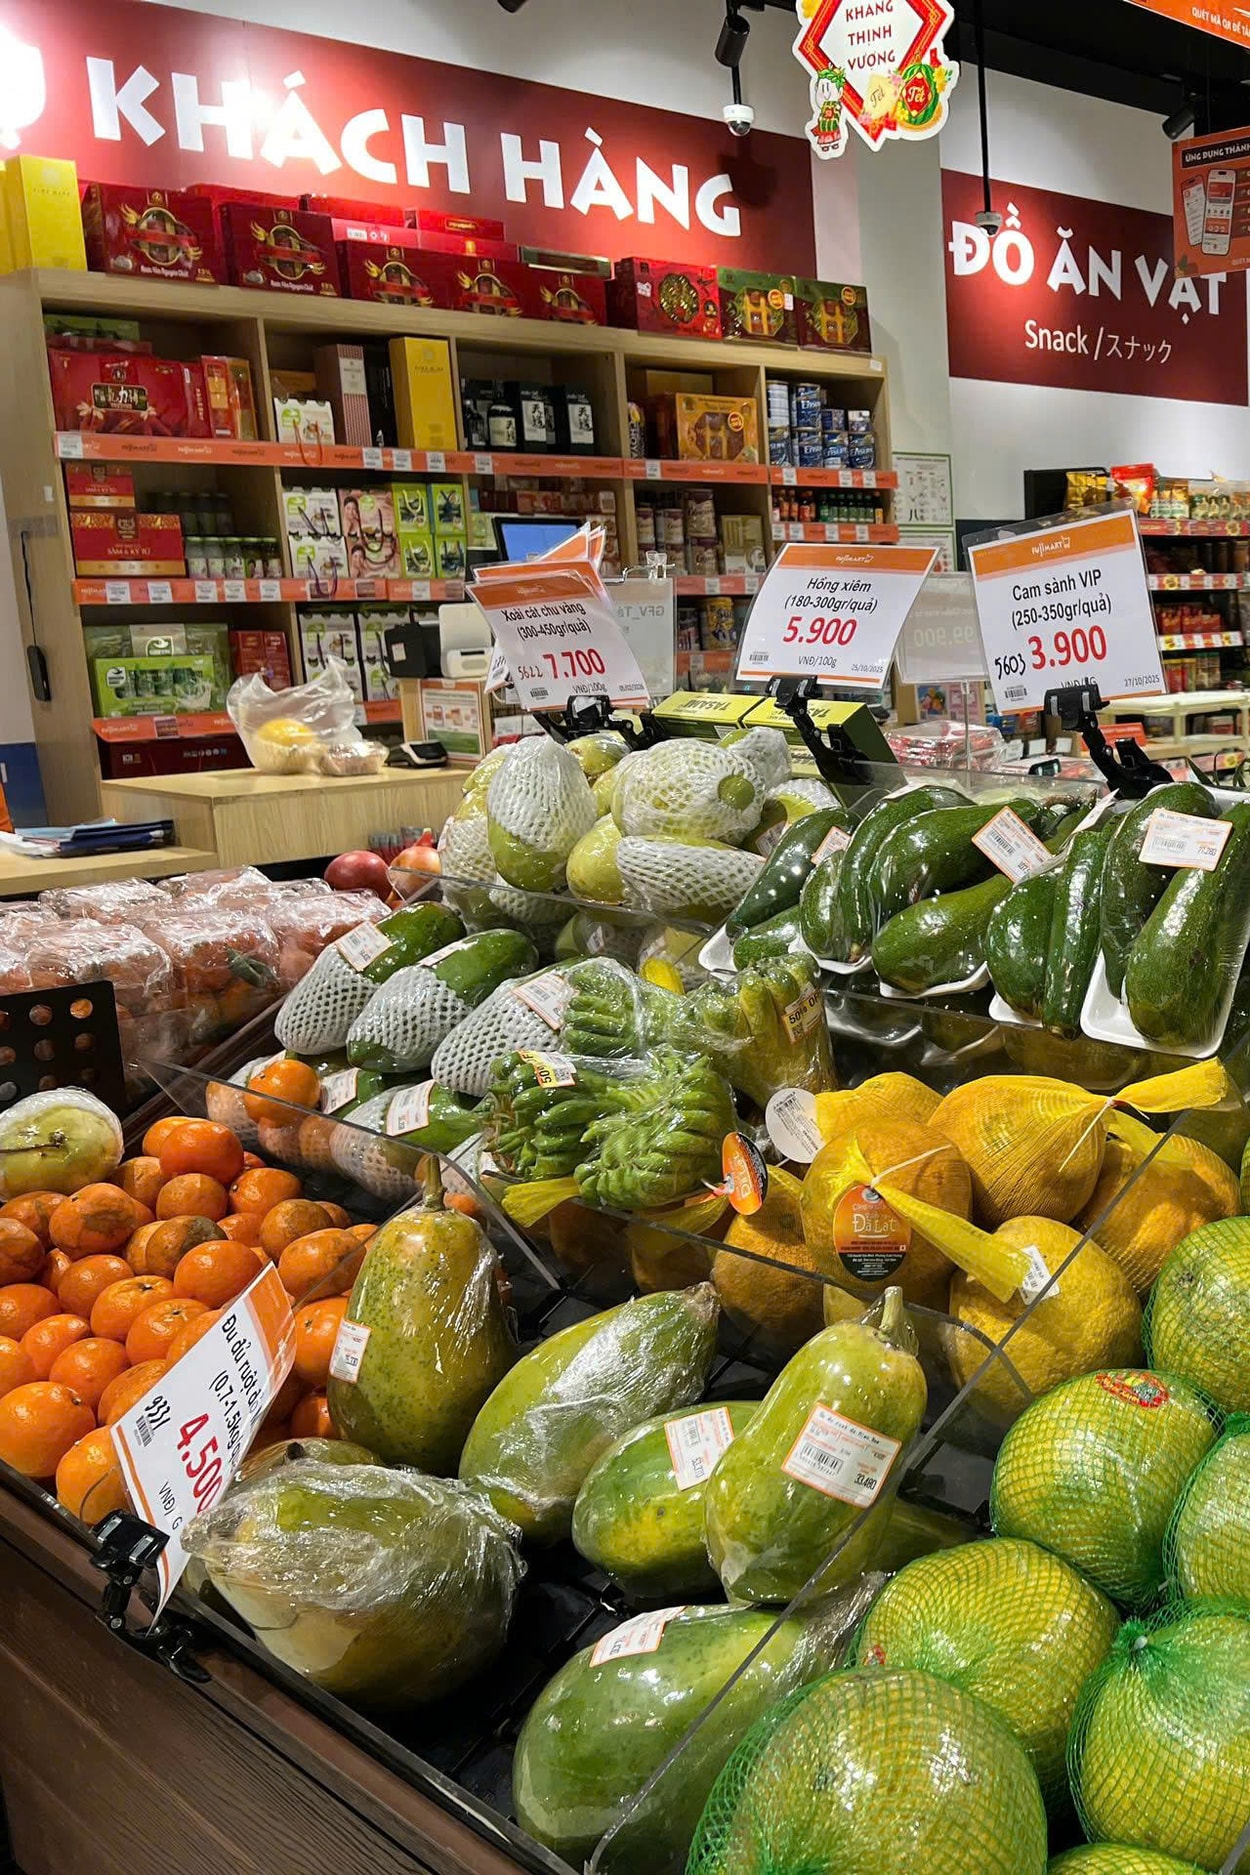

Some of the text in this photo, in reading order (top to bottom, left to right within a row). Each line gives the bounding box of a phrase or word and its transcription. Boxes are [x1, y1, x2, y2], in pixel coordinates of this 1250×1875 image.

[845, 0, 894, 22] KHANG
[1191, 7, 1210, 21] QUÉT
[1210, 12, 1222, 25] MÃ
[847, 25, 893, 46] THỊNH
[86, 56, 471, 194] KHÁCH
[500, 126, 742, 237] HÀNG
[948, 202, 1035, 286] ĐỒ
[1046, 225, 1122, 301] ĂN
[1024, 319, 1089, 355] Snack
[806, 576, 872, 594] Hồng xiêm
[1012, 568, 1102, 601] Cam sành VIP
[500, 601, 587, 622] Xoài cát chu vàng
[784, 594, 878, 615] (180-300gr/quả)
[1011, 592, 1112, 630] (250-350gr/quả)
[516, 618, 591, 642] (300-450gr/quả)
[783, 616, 858, 646] 5.900
[798, 655, 837, 669] VNĐ/100g
[1027, 625, 1108, 670] 3.900
[542, 648, 606, 680] 7.700
[994, 652, 1026, 680] 5603
[1124, 674, 1160, 688] 27/10/2025
[221, 1313, 238, 1343] Đu
[231, 1338, 252, 1364] đủ
[238, 1360, 258, 1396] ruột
[177, 1413, 223, 1514] 4.500
